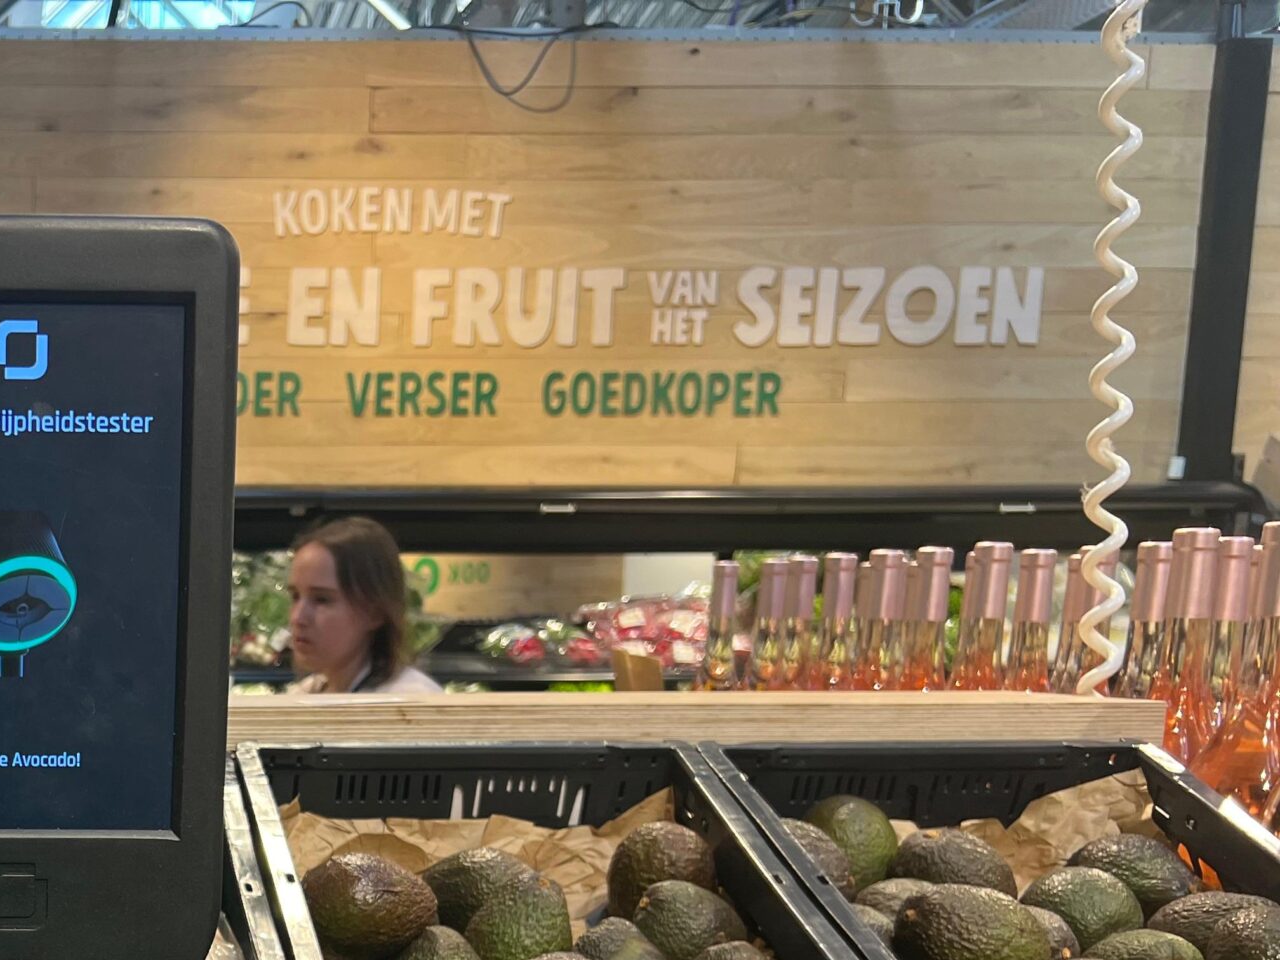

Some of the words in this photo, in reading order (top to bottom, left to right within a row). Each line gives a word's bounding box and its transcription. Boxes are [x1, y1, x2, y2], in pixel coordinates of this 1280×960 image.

[272, 185, 413, 238] KOKEN
[419, 191, 515, 238] MET
[286, 266, 383, 348] EN
[411, 266, 626, 350] FRUIT
[647, 270, 719, 307] VAN
[734, 264, 1044, 348] SEIZOEN
[649, 308, 708, 348] HET
[347, 369, 499, 419] VERSER
[541, 371, 783, 419] GOEDKOPER
[12, 751, 81, 768] Avocado!
